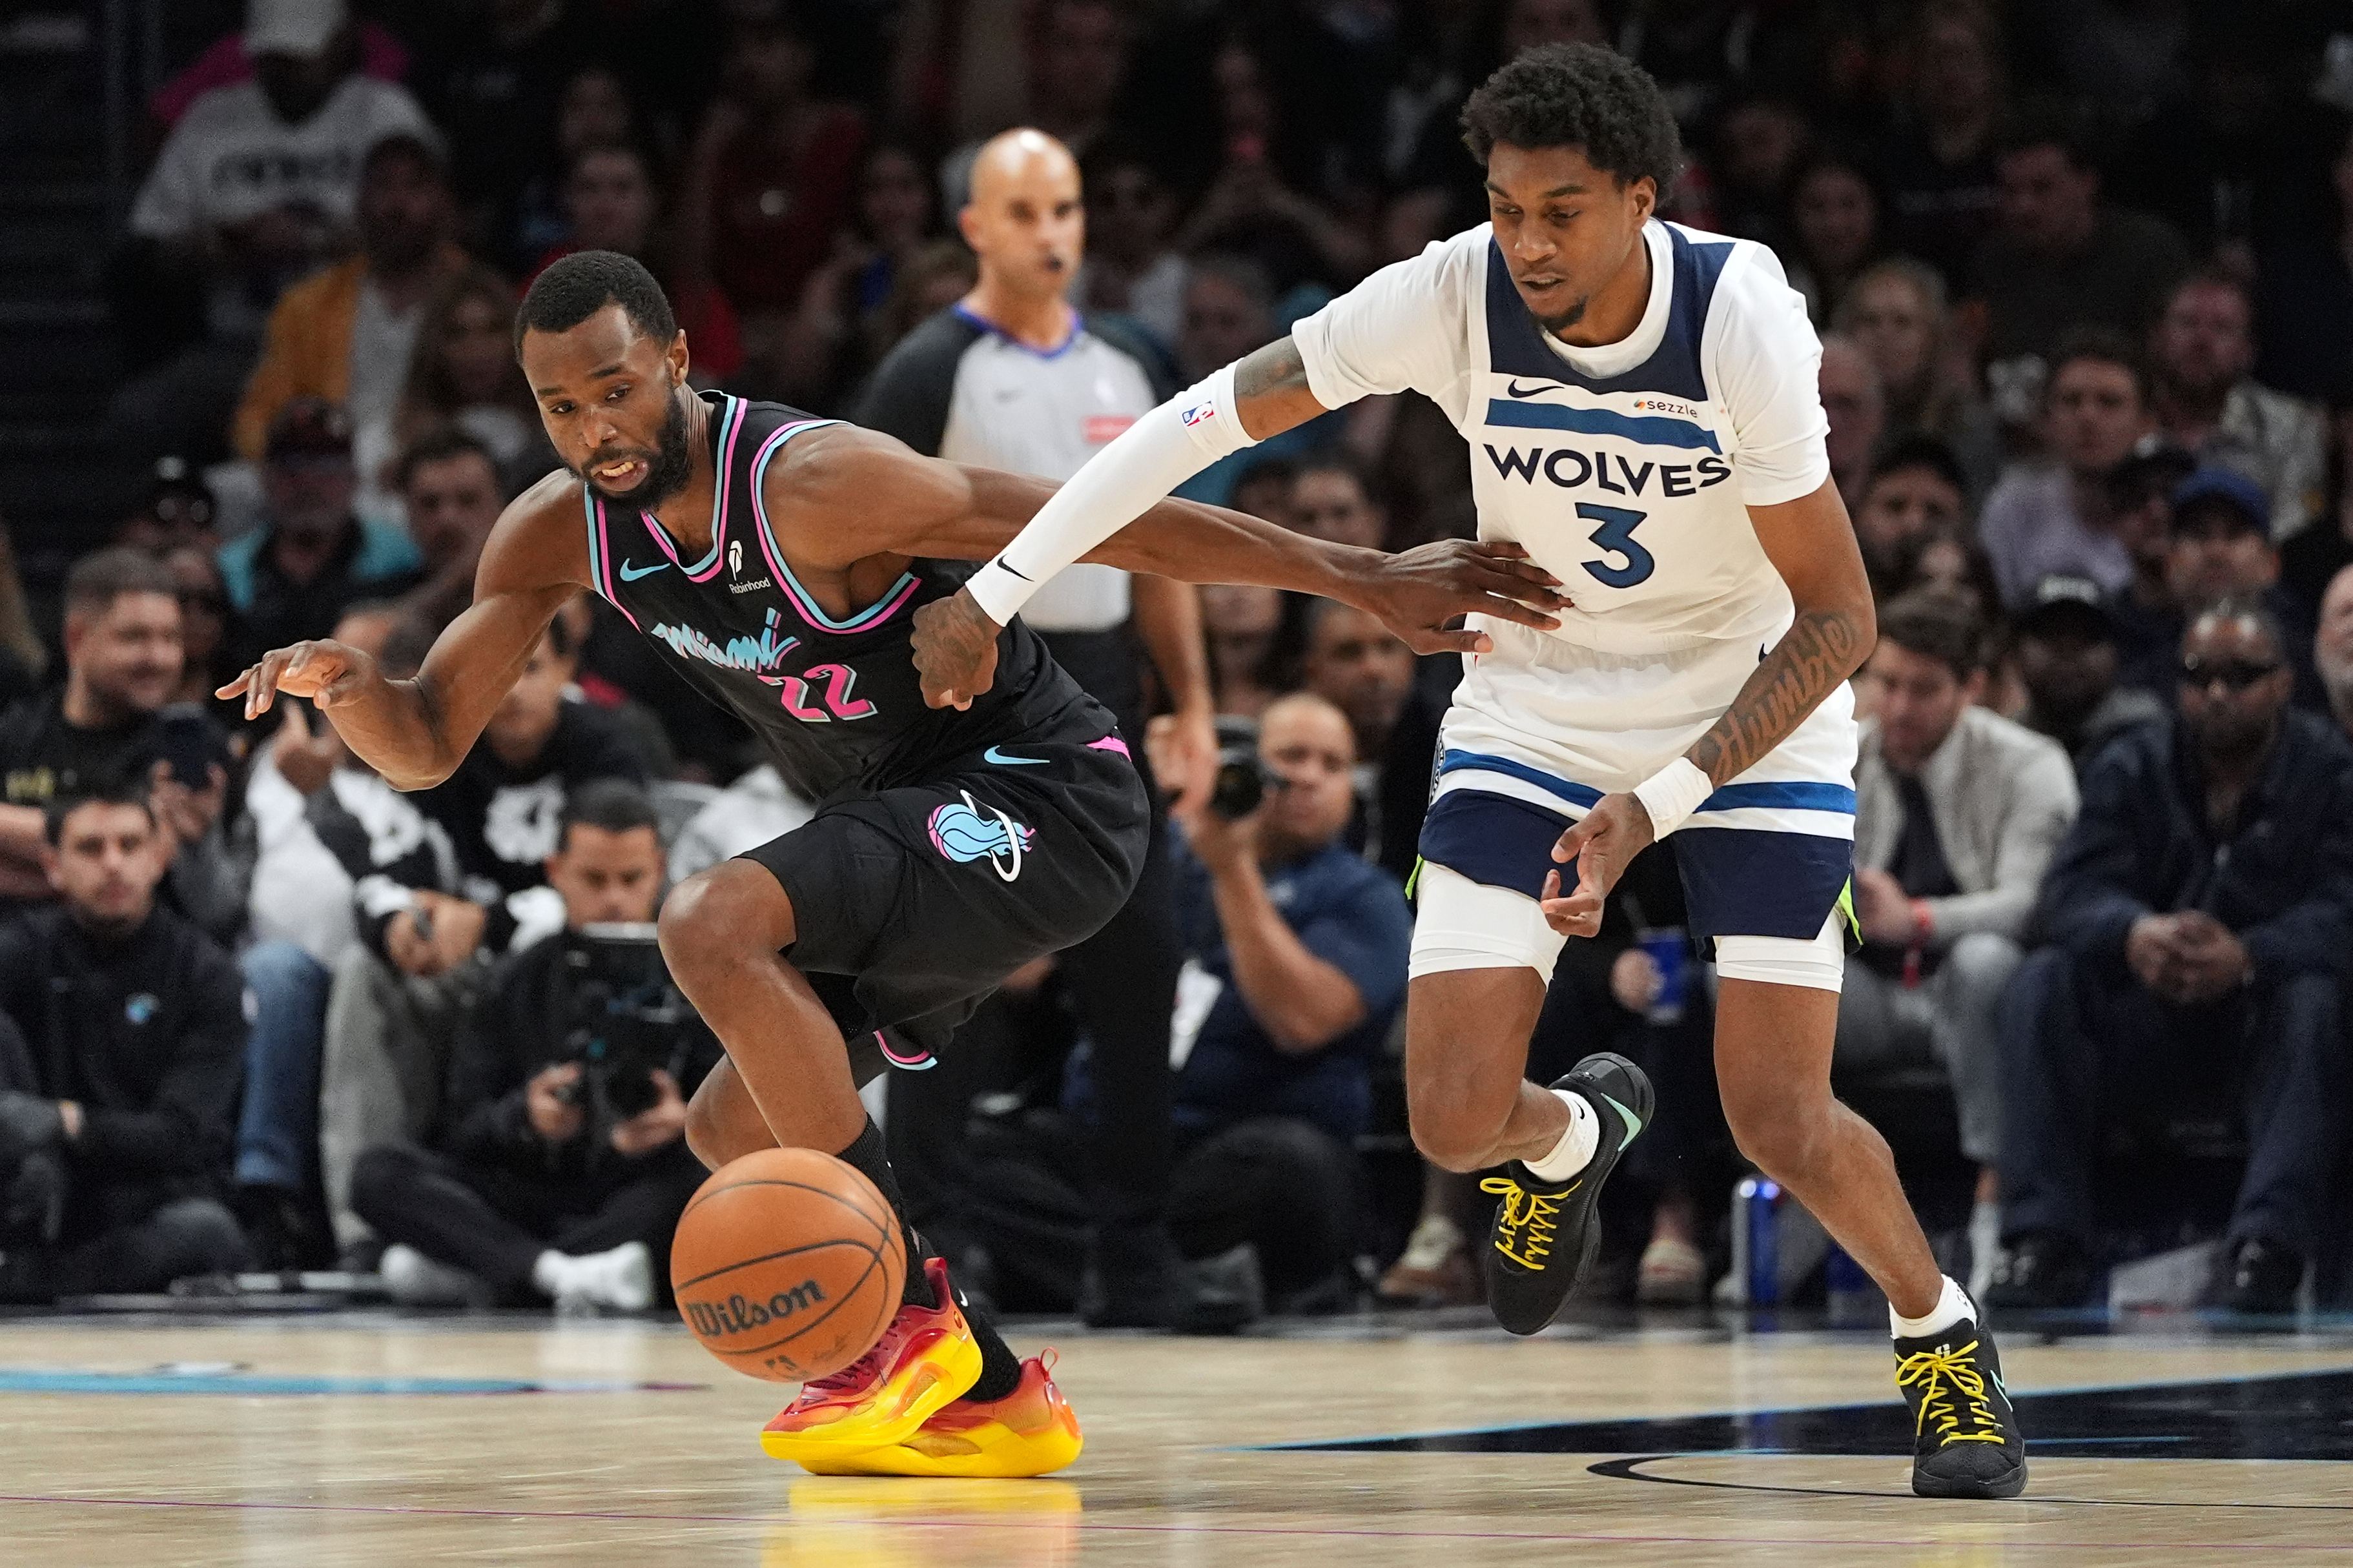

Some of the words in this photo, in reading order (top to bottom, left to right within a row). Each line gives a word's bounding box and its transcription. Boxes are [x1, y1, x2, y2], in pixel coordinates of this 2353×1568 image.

[1647, 401, 1698, 418] sezzle
[1483, 443, 1732, 498] WOLVES
[1574, 502, 1655, 589] 3
[729, 576, 771, 594] Robinhood
[651, 607, 801, 673] Miami
[757, 664, 878, 722] 22
[686, 1279, 826, 1336] Wilson
